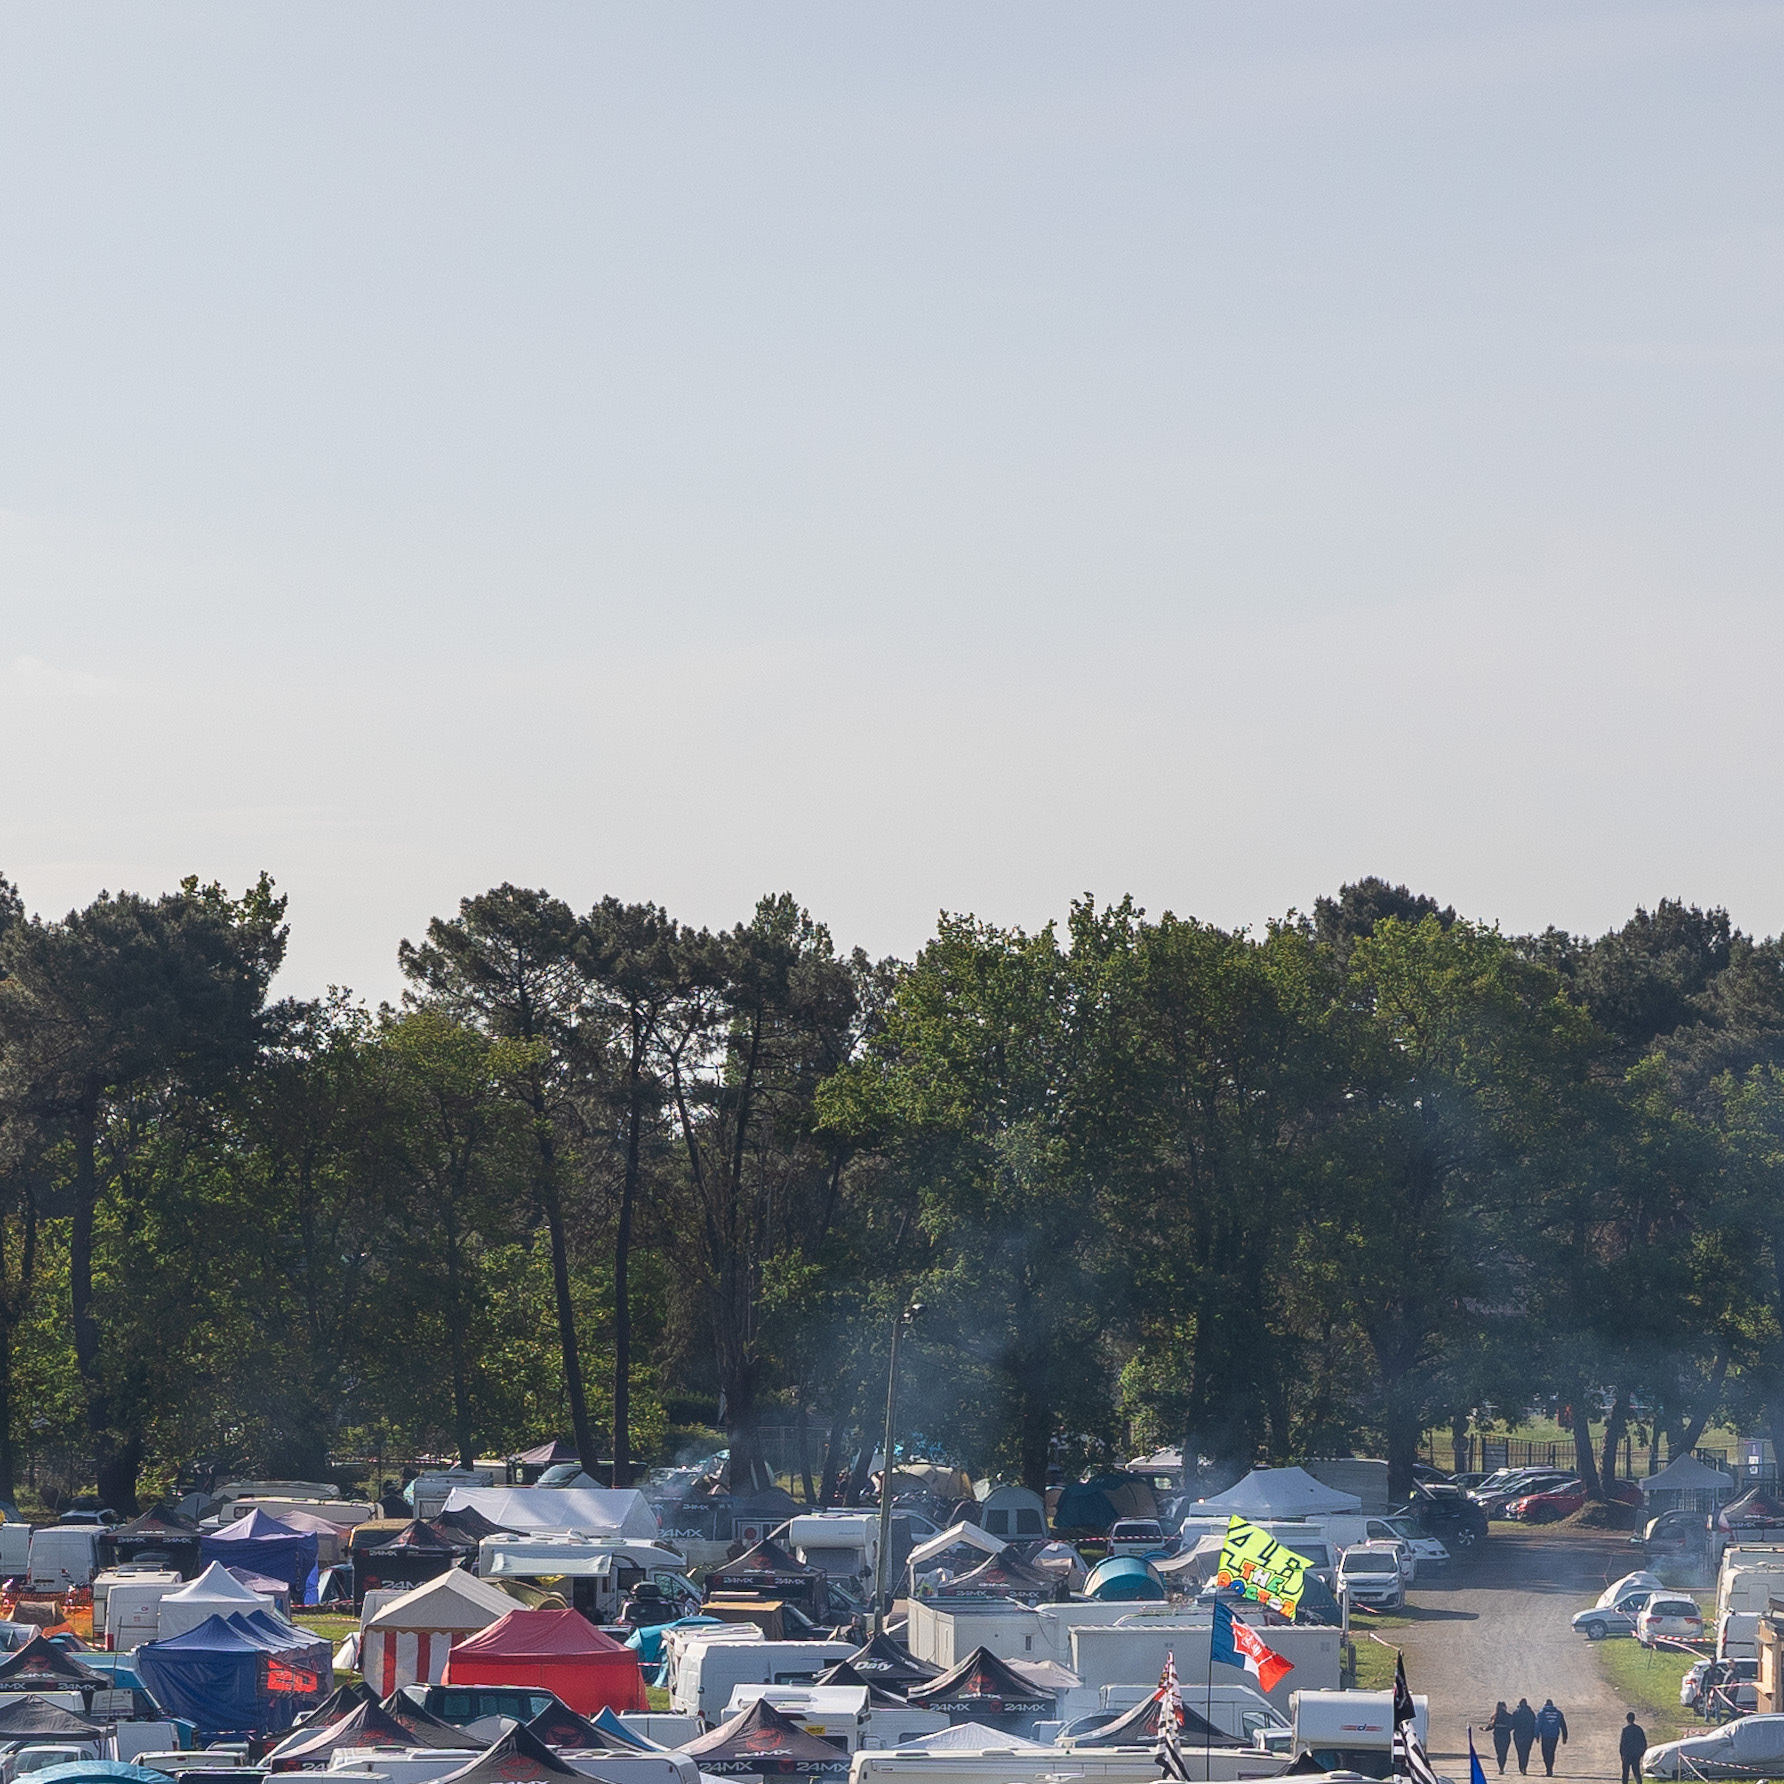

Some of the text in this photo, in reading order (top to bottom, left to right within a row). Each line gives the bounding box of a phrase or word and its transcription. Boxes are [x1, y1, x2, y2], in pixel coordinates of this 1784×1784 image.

[1241, 1560, 1285, 1595] THE
[1218, 1571, 1295, 1618] DOCTOR
[854, 1661, 895, 1671] Dafy
[57, 1682, 97, 1691] 24MX
[929, 1703, 972, 1712] 24MX
[1004, 1703, 1047, 1713] 24MX
[734, 1749, 793, 1758] 24MX
[699, 1761, 753, 1773] 24MX
[796, 1761, 850, 1773] 24MX
